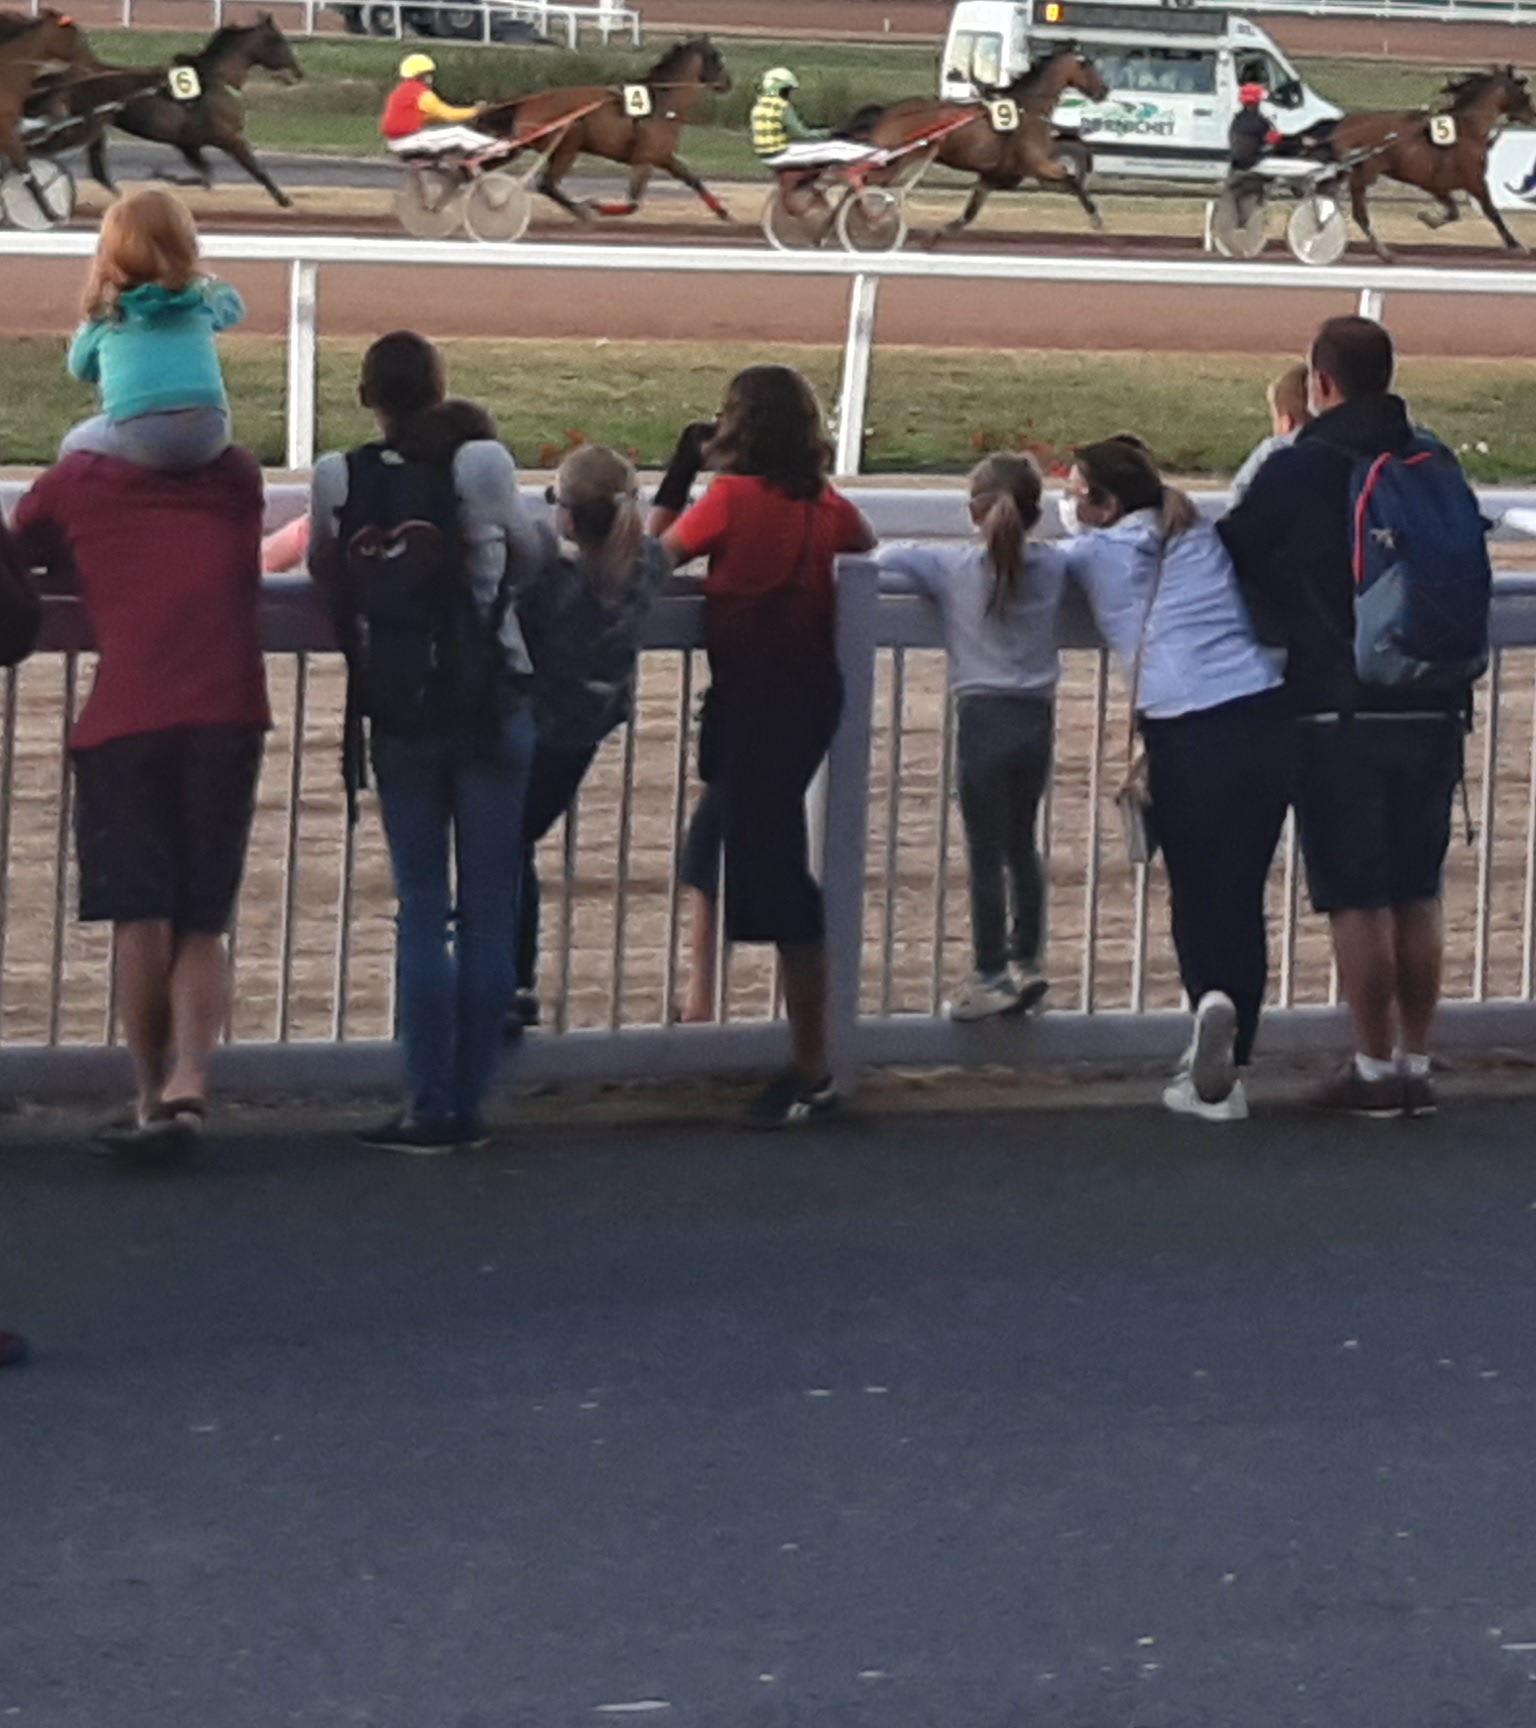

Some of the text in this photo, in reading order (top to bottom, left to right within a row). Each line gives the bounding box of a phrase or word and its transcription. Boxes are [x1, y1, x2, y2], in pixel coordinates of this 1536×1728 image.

[175, 71, 192, 94] 6
[630, 89, 644, 111] 4
[997, 103, 1013, 127] 9
[1436, 119, 1450, 140] 5
